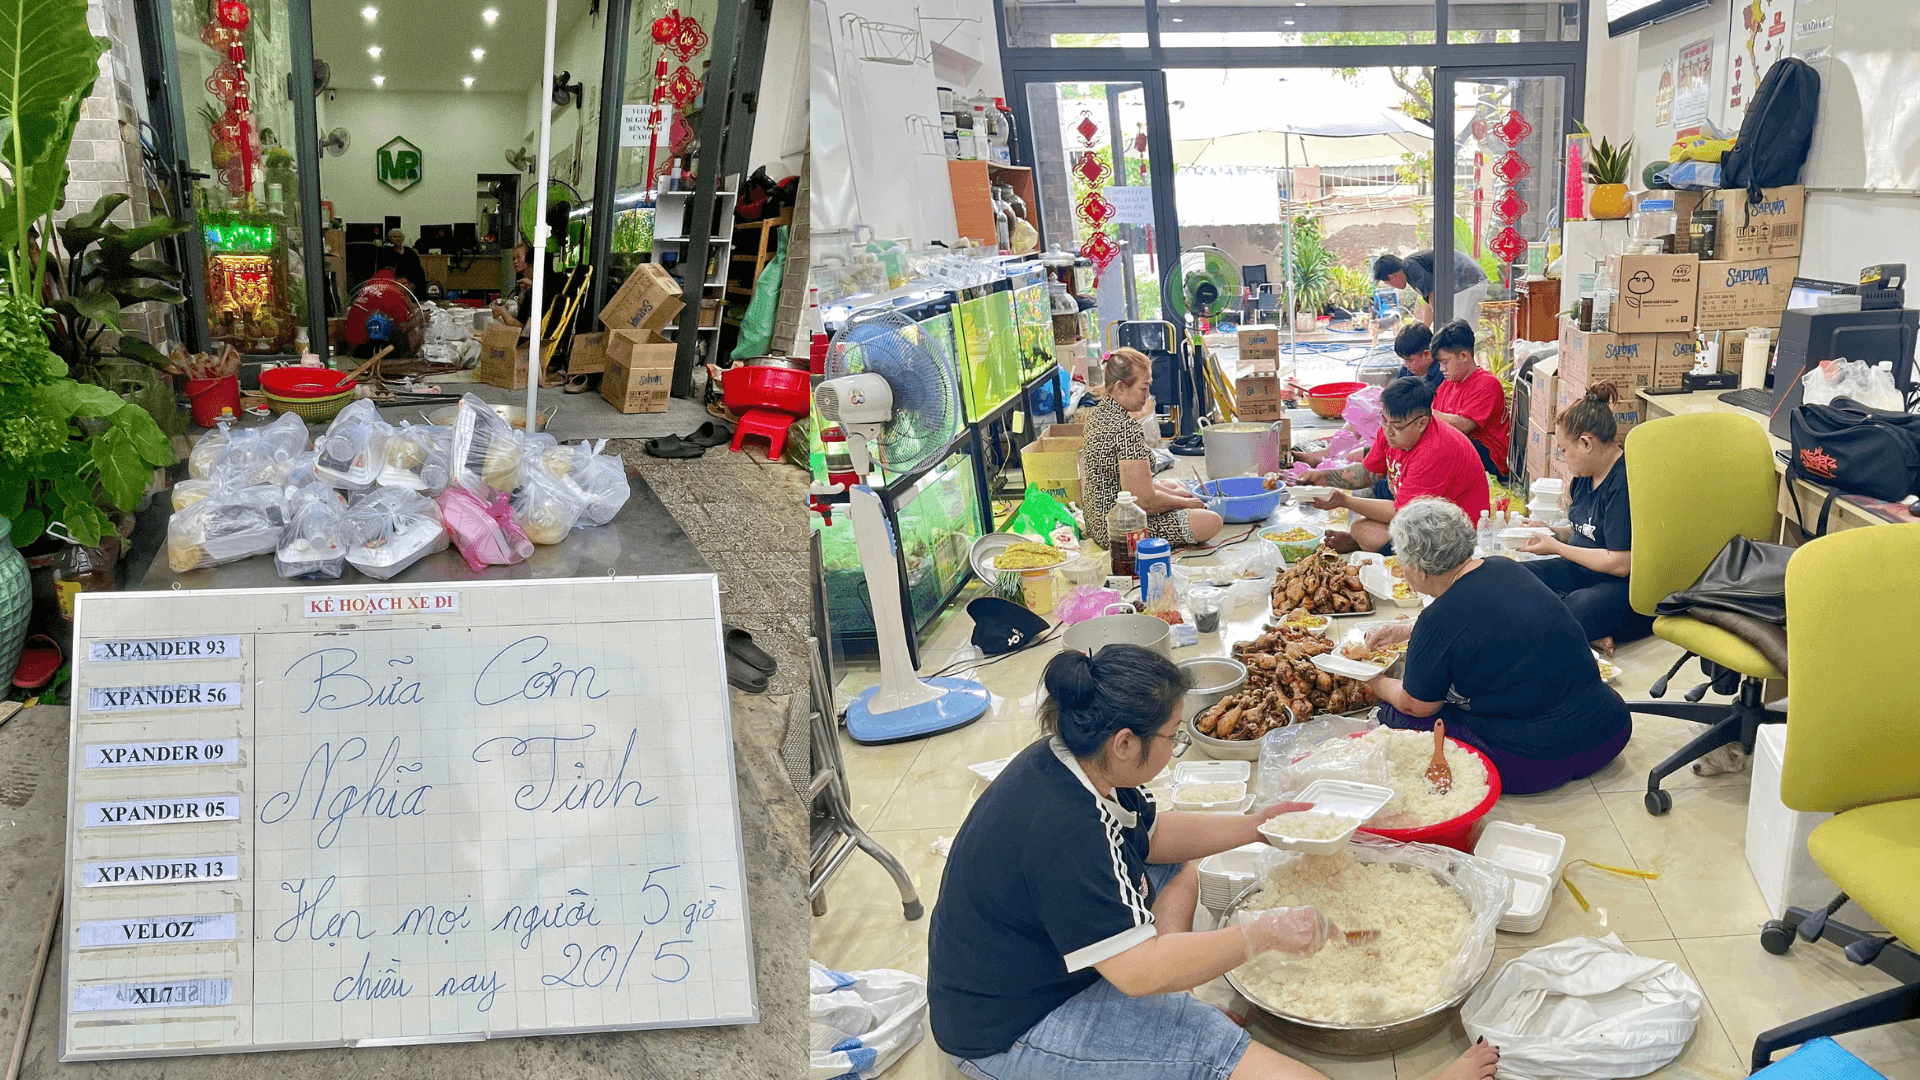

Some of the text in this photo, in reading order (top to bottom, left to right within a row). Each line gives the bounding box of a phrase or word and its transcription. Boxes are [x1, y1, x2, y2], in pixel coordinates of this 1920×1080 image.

[1726, 266, 1769, 287] SAPUWA
[1605, 343, 1638, 358] SAPUWA
[1614, 410, 1638, 424] APUWA
[339, 597, 402, 614] HOẠCH
[407, 596, 430, 609] XE
[435, 595, 453, 608] ĐI
[105, 640, 226, 658] XPANDER 93
[284, 636, 610, 713] Bữa Cơm
[104, 689, 202, 706] XPANDER
[207, 688, 227, 703] 56
[100, 744, 224, 764] XPANDER 09
[261, 735, 433, 849] Nghĩa
[100, 802, 225, 822] XPANDER 05
[98, 862, 224, 883] XPANDER 13
[274, 875, 377, 947] Hẹn
[393, 895, 471, 944] mọi
[641, 865, 681, 925] 5
[122, 922, 195, 940] VELOZ
[133, 986, 174, 1004] XL7
[435, 971, 507, 1012] nay
